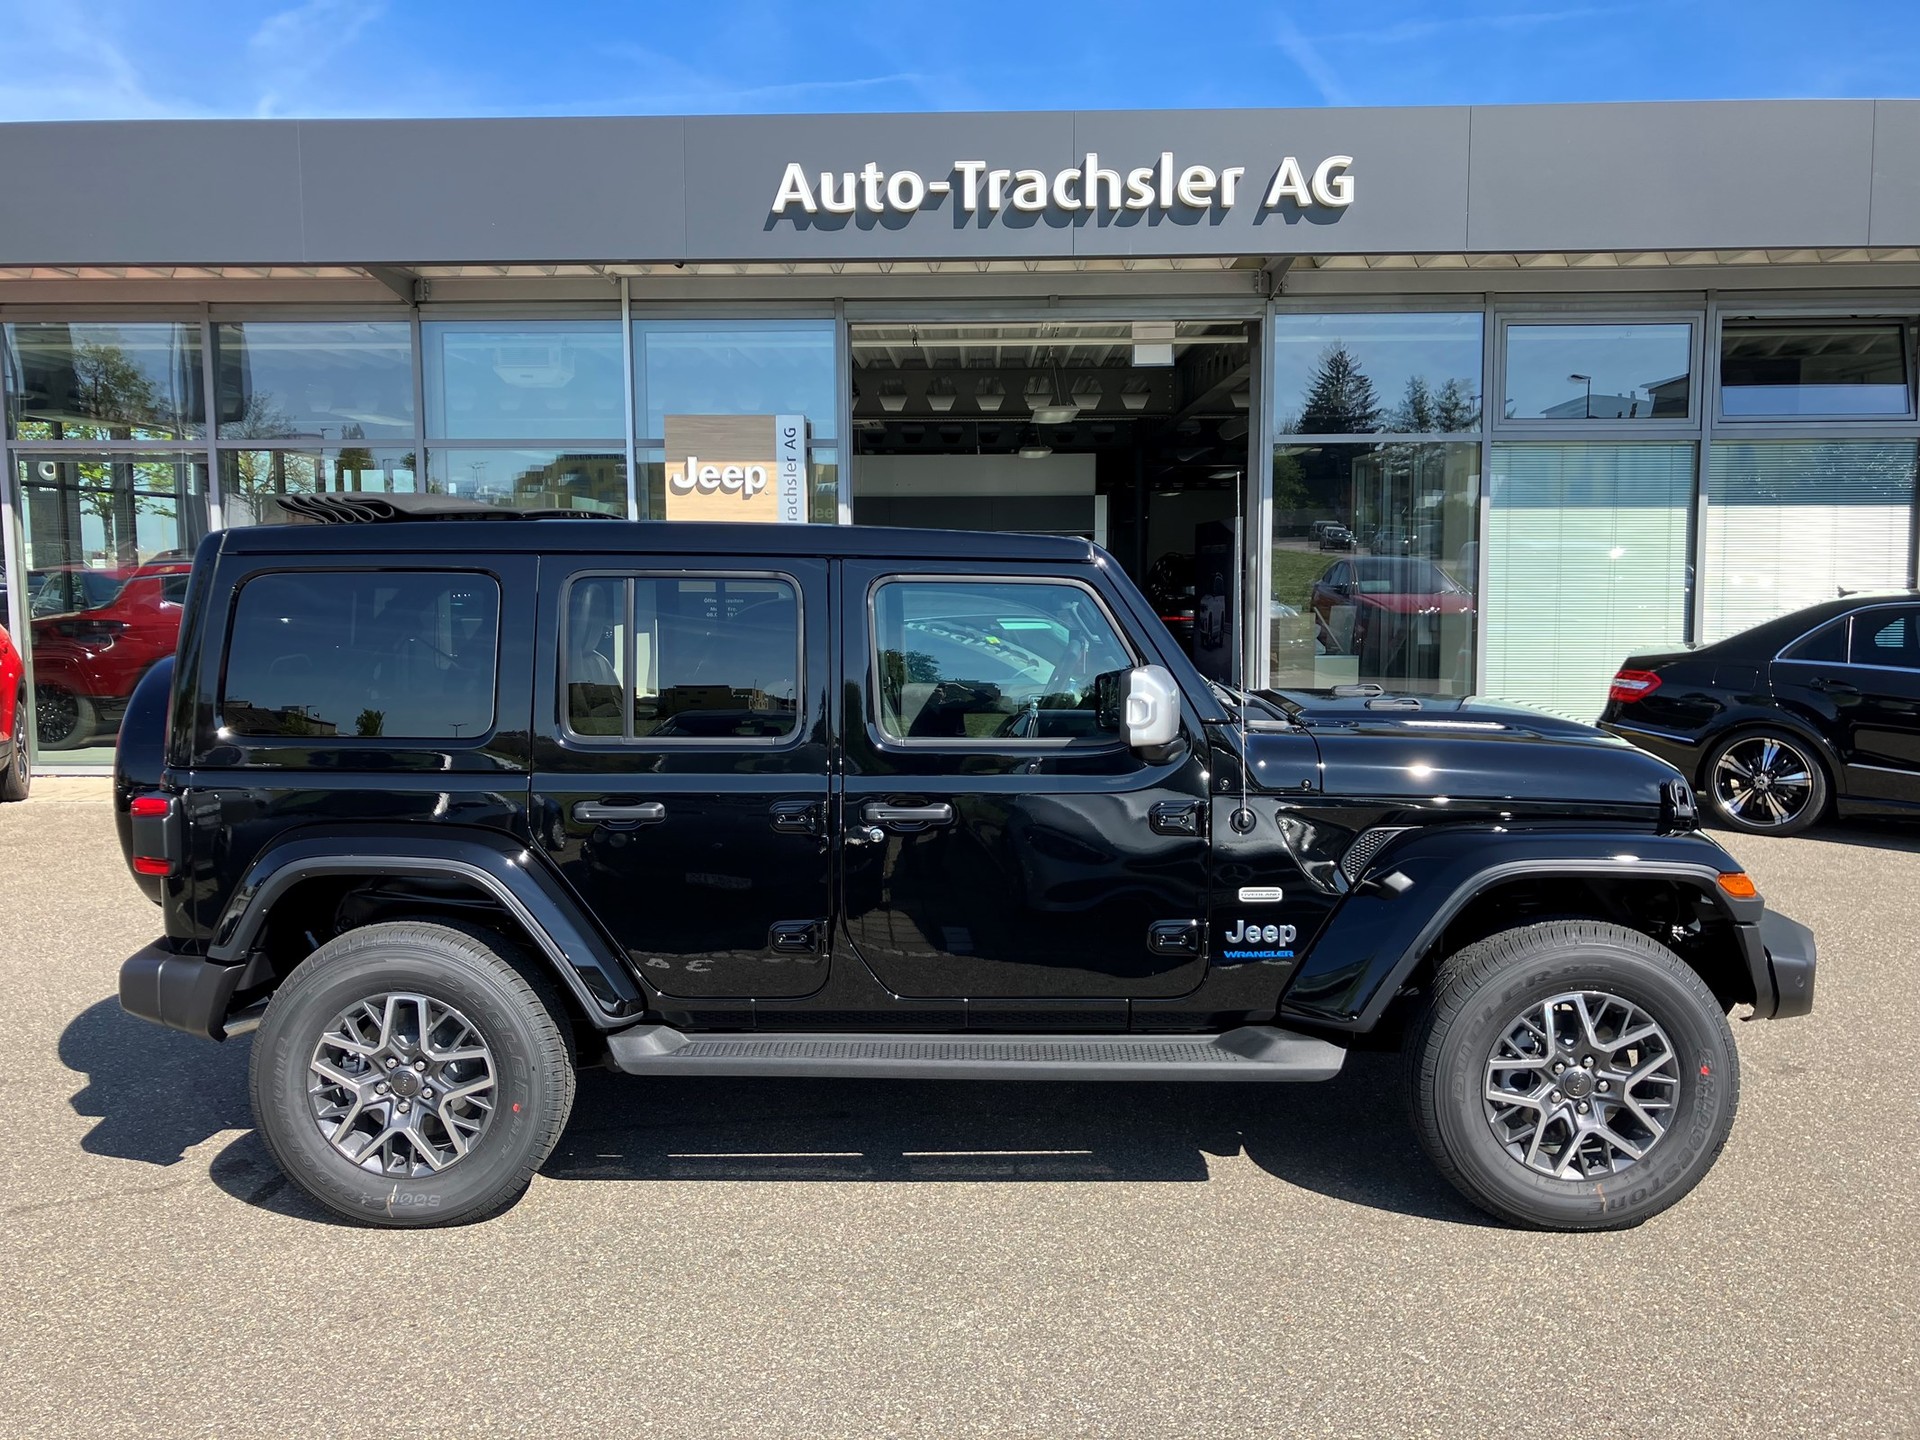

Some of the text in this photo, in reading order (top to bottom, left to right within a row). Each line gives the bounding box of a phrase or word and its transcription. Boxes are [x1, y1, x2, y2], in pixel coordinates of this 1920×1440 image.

[772, 151, 1356, 214] Auto-Trachsler AG
[672, 456, 769, 495] Jeep
[783, 427, 798, 521] rachsler AG
[1225, 919, 1297, 947] Jeep
[1223, 950, 1294, 958] WRANGLER
